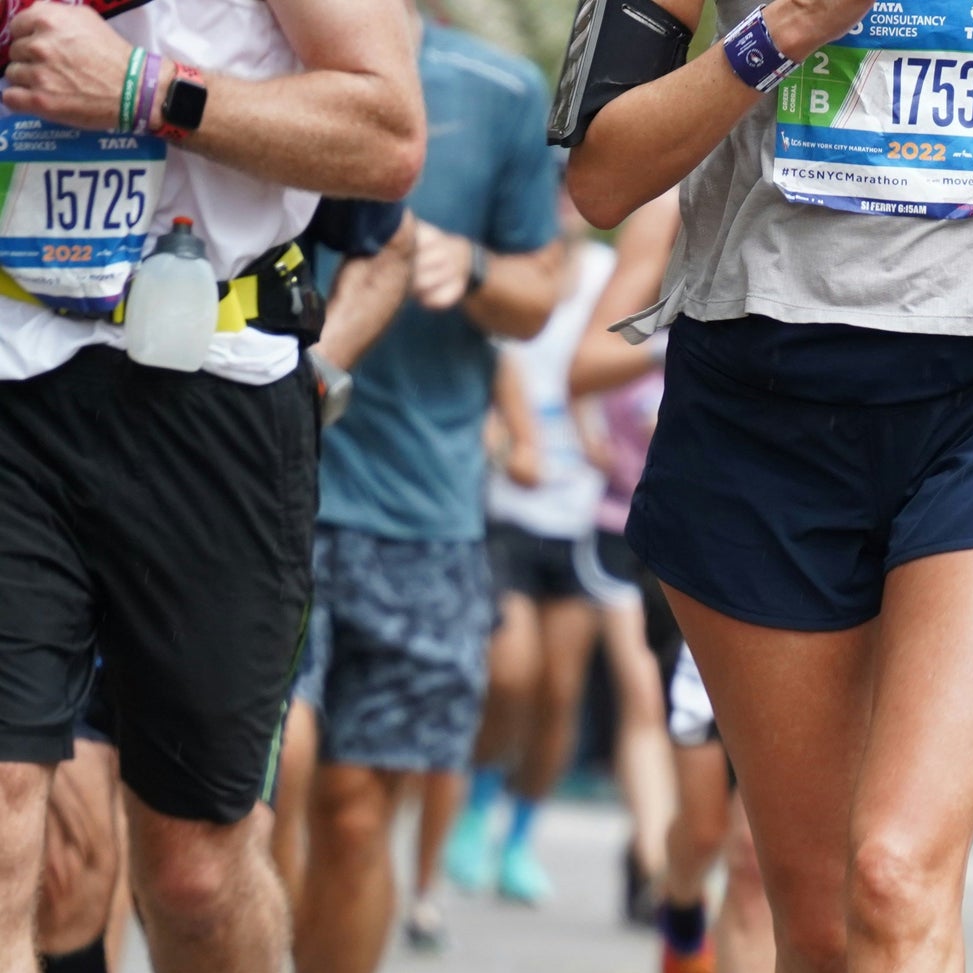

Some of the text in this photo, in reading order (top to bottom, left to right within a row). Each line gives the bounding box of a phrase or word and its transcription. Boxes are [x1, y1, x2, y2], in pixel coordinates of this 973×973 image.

[873, 1, 904, 13] TATA
[870, 14, 946, 27] CONSULTANCY
[869, 26, 918, 38] SERVICES
[813, 51, 830, 75] 2
[789, 83, 797, 113] CORRAL
[809, 88, 830, 114] B
[14, 119, 42, 130] TATA
[98, 136, 138, 150] TATA
[802, 141, 816, 149] NEW
[816, 142, 833, 150] YORK
[848, 145, 883, 154] MARATHON
[887, 140, 946, 162] 2022
[781, 167, 908, 186] #TCSNYCMarathon
[44, 168, 147, 231] 15725
[870, 201, 897, 214] FERRY
[898, 204, 927, 215] 6:15AM
[42, 244, 93, 263] 2022
